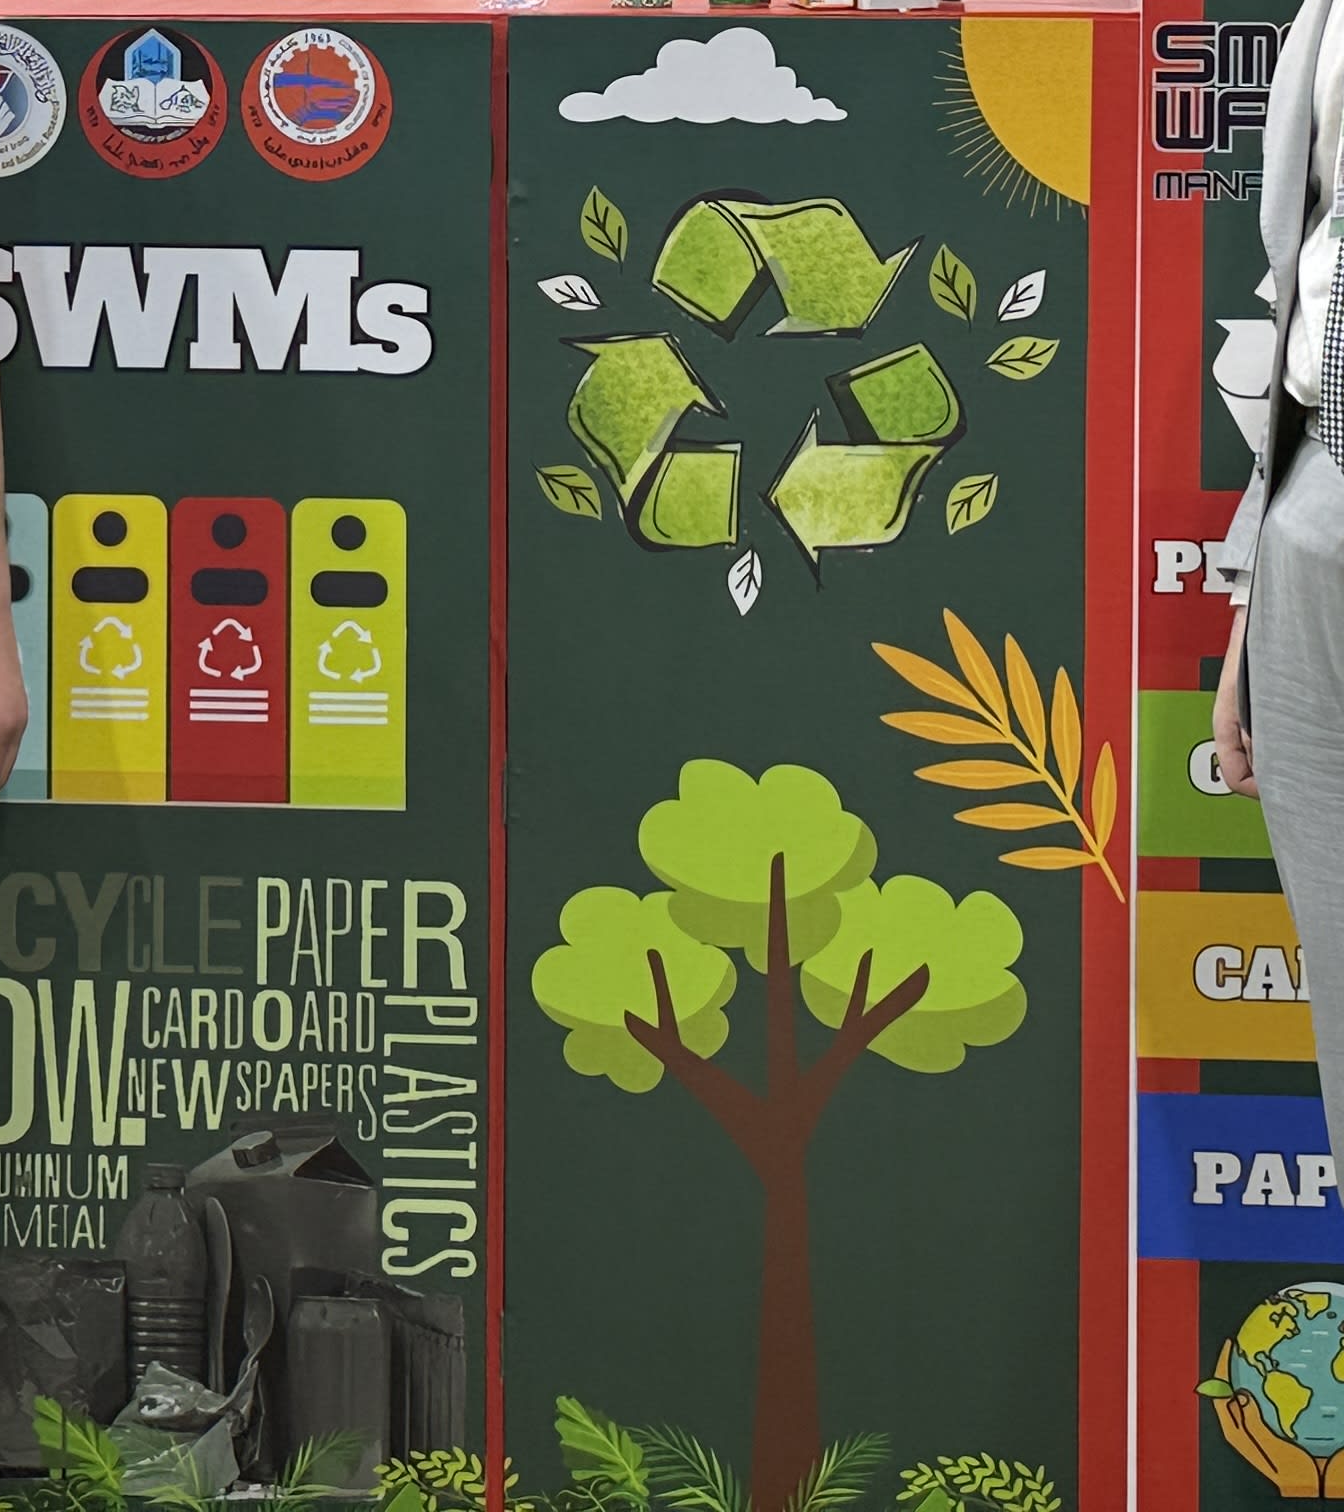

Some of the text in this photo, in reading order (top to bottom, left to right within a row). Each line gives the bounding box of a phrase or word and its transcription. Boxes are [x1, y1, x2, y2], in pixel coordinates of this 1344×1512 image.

[256, 877, 468, 990] PAPER
[142, 986, 376, 1053] CARDOARD
[127, 1057, 377, 1142] NEWSPAPERS
[381, 994, 478, 1278] PLASTICS
[3, 1203, 107, 1250] METAL
